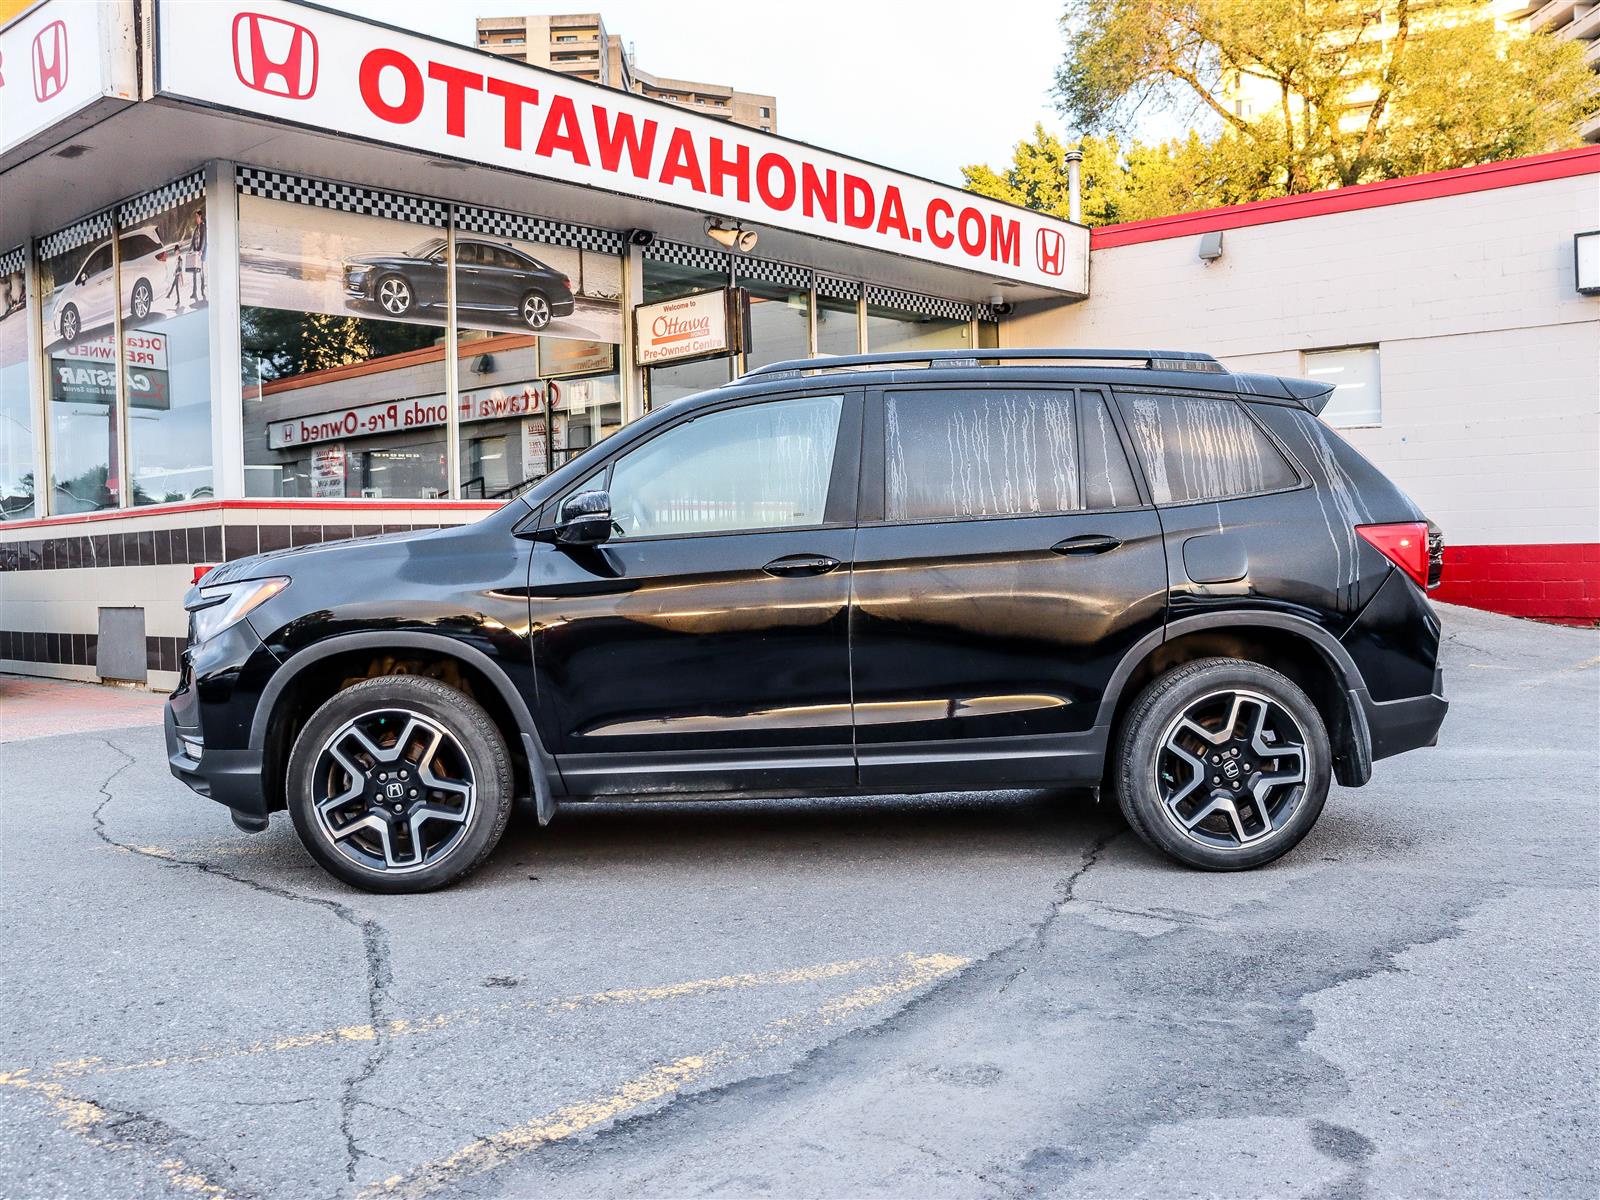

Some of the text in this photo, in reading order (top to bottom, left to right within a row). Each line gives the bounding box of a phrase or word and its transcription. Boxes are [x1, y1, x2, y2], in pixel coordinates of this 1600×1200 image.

[358, 48, 1020, 267] OTTAWAHONDA.COM
[663, 300, 696, 313] Welcome to
[652, 315, 710, 337] Ottawa
[643, 338, 722, 360] Pre-Owned Centre
